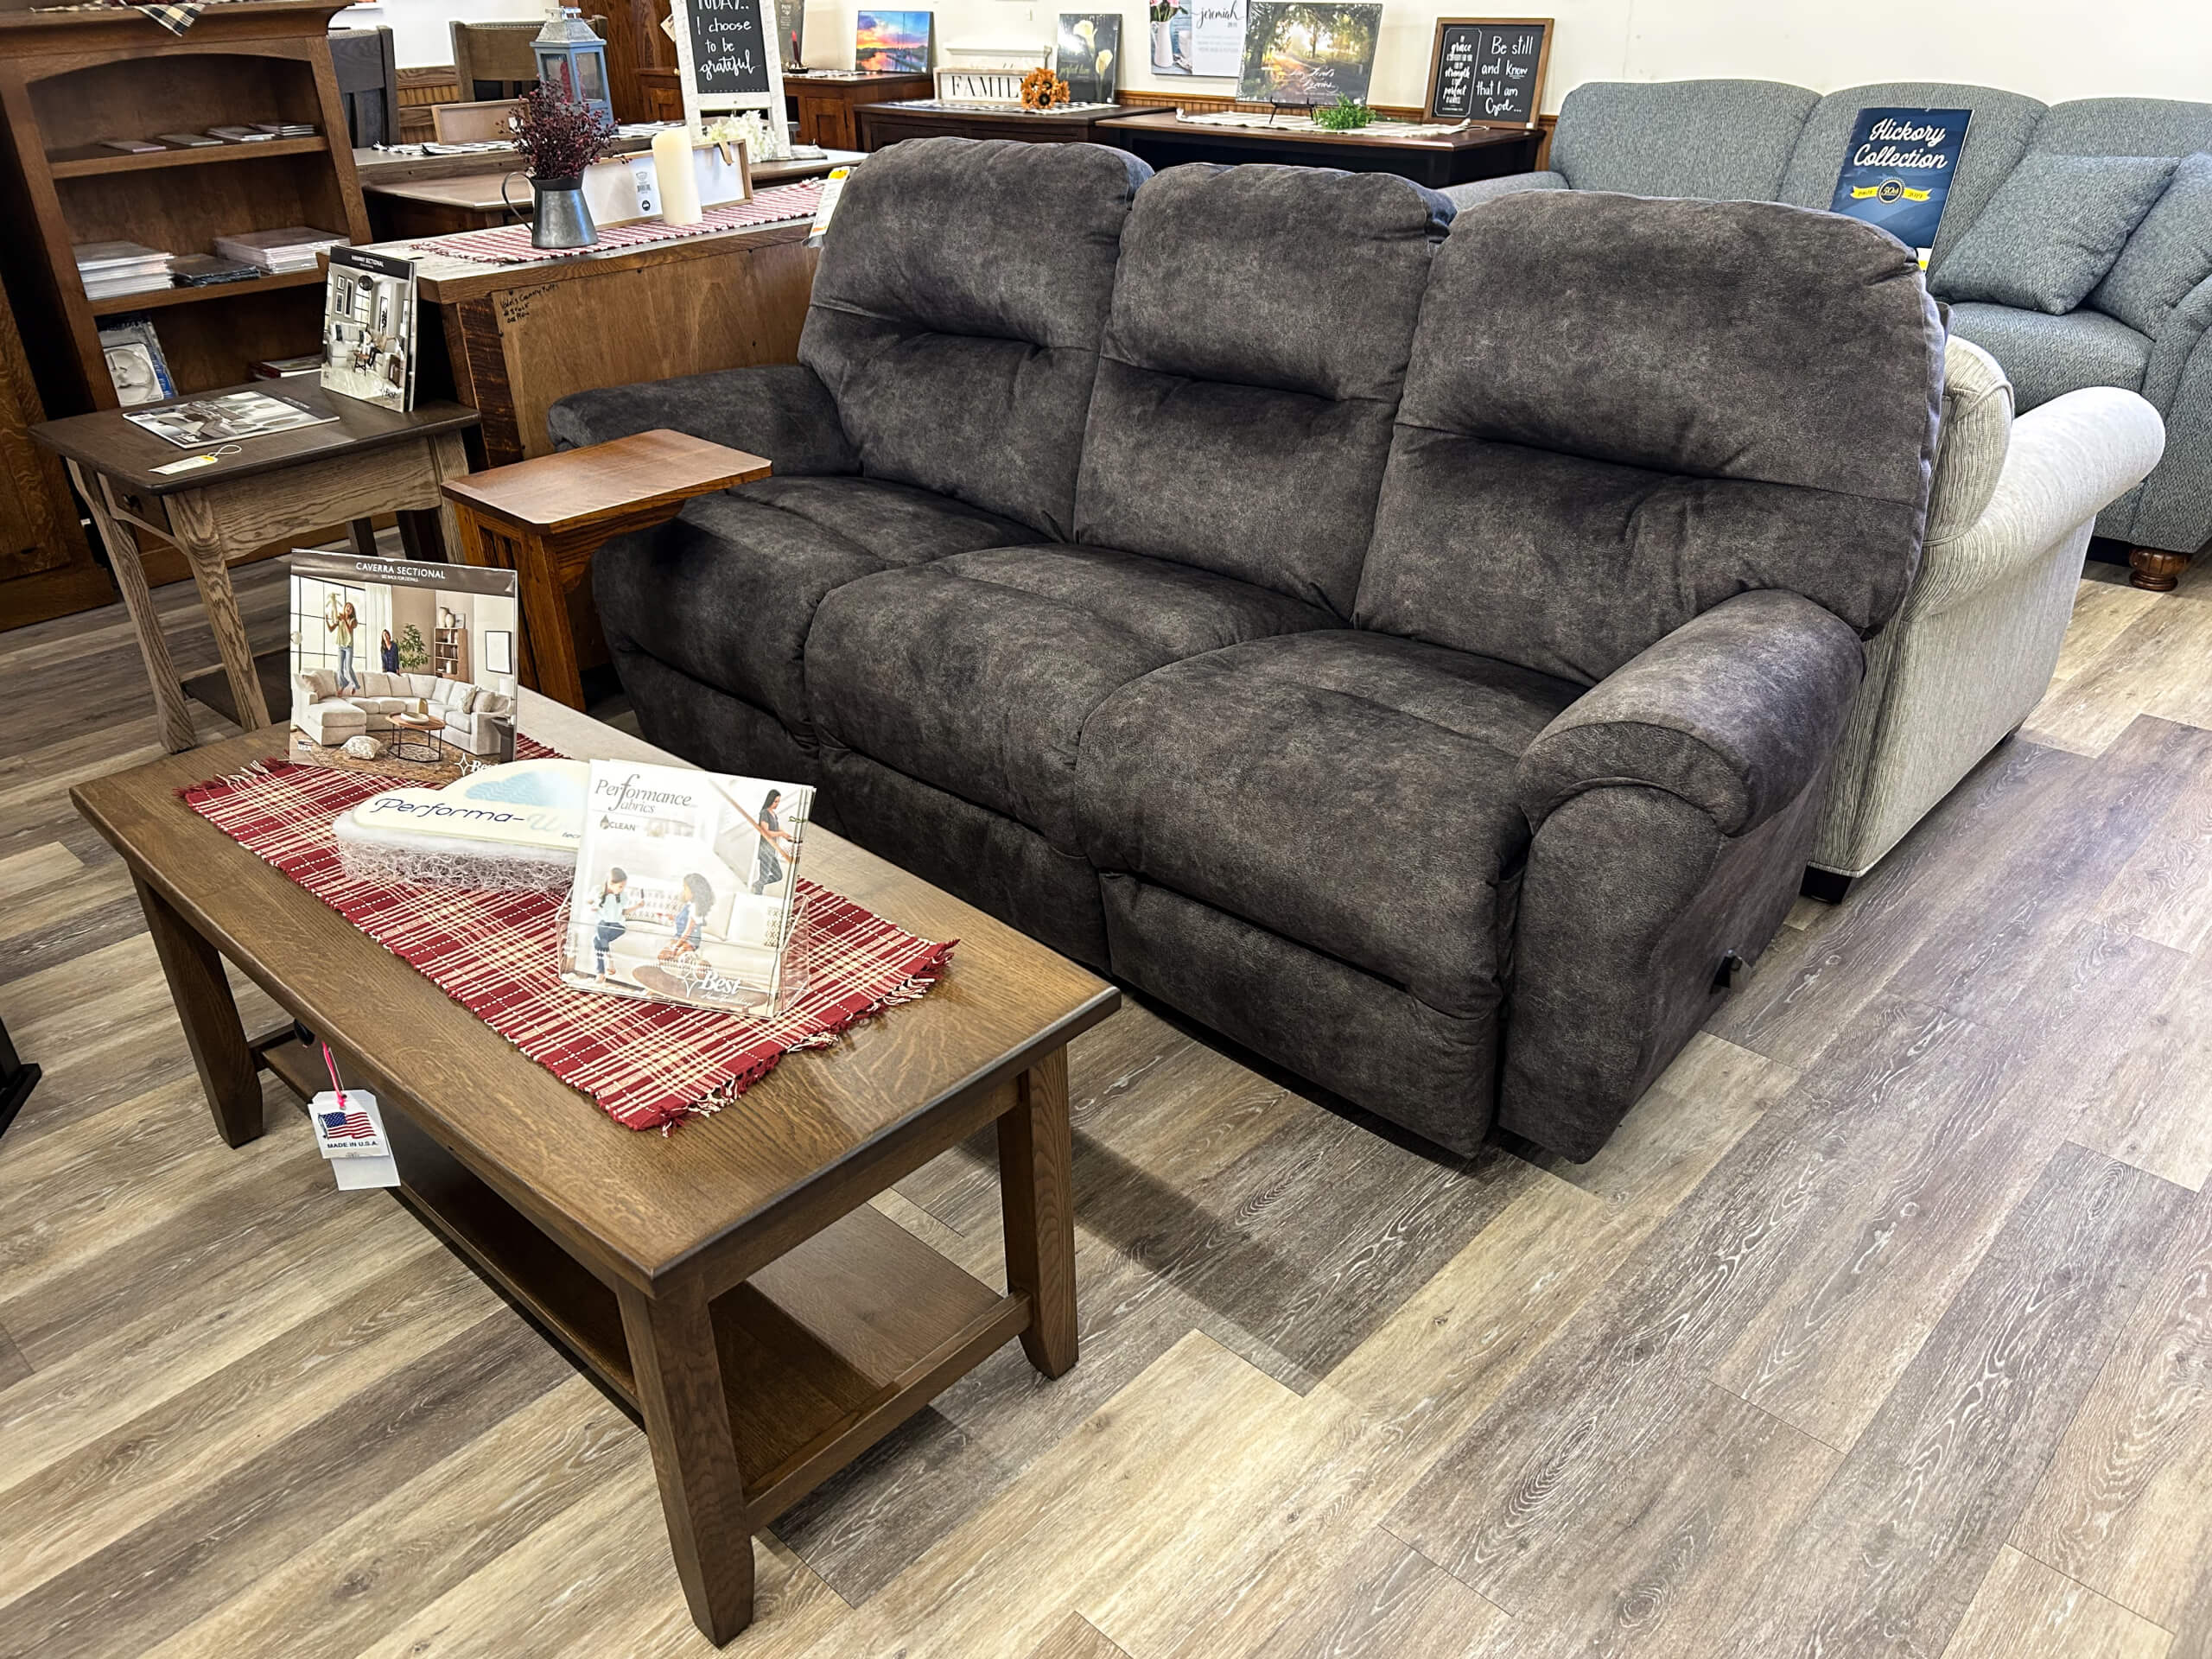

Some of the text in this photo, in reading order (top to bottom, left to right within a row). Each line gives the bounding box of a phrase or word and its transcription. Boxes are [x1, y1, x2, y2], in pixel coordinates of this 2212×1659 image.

[696, 16, 752, 35] I choose
[704, 37, 734, 54] to be
[1491, 35, 1533, 54] Be still
[698, 49, 760, 80] grateful
[1481, 58, 1501, 74] and
[1505, 60, 1528, 76] know
[1477, 80, 1494, 96] that
[1497, 80, 1501, 95] I
[1503, 87, 1518, 97] am
[1869, 118, 1946, 147] Hickory
[1853, 143, 1948, 169] Collection
[356, 563, 446, 579] CAVERRA SECTIONAL
[470, 760, 492, 773] Be
[594, 773, 692, 810] Performance
[698, 970, 741, 995] Best
